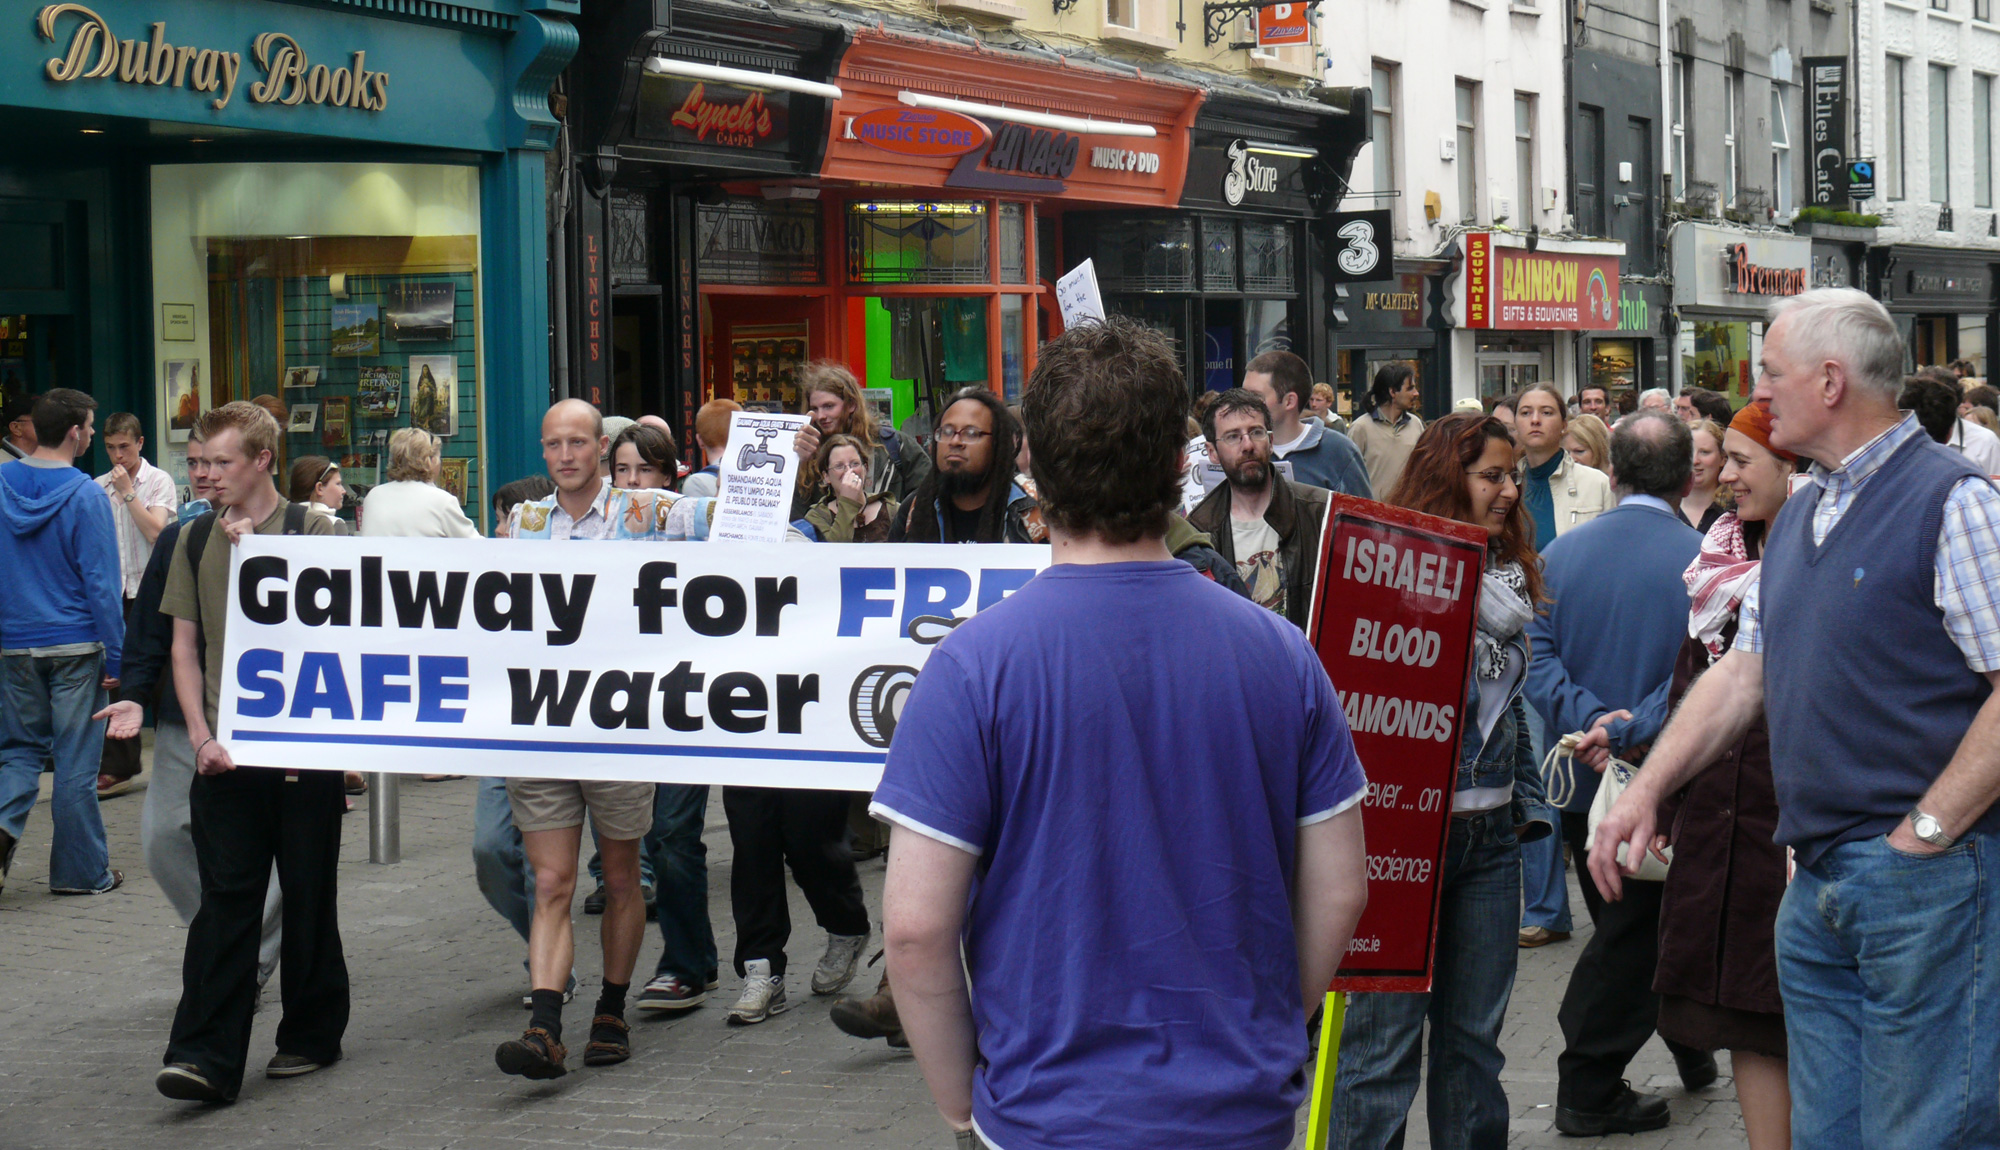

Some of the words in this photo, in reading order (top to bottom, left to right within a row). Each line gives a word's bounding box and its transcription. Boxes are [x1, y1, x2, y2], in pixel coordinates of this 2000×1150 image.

[37, 3, 241, 110] Dubray
[251, 32, 390, 112] Books
[671, 81, 772, 141] Lynch's
[861, 123, 913, 142] MUSIC
[919, 128, 972, 146] STORE
[1092, 147, 1125, 170] MUSIC
[1126, 151, 1136, 172] &
[1138, 152, 1159, 174] DVD
[1224, 139, 1246, 206] 3
[1246, 157, 1278, 193] Store
[1817, 148, 1841, 203] Cafe
[1337, 220, 1379, 275] 3
[1730, 242, 1806, 296] Brennans
[588, 235, 599, 361] LYNCHS
[1472, 241, 1484, 320] SOUVENIRS
[1502, 258, 1578, 303] RAINBOW
[682, 259, 692, 368] LYNCHS
[1503, 306, 1525, 321] GIFTS
[1527, 307, 1533, 321] &
[1535, 307, 1578, 322] SOUVENIRS
[360, 379, 400, 387] IRELAND
[728, 474, 764, 485] DEMANDAMOS
[728, 485, 743, 494] GRATIS
[751, 498, 757, 506] DE
[758, 498, 780, 508] GALWAY
[1342, 536, 1465, 601] ISRAELI
[238, 555, 597, 646] Galway
[634, 560, 797, 637] for
[1349, 618, 1441, 668] BLOOD
[236, 648, 470, 723] SAFE
[508, 660, 819, 735] water
[1418, 787, 1442, 812] on
